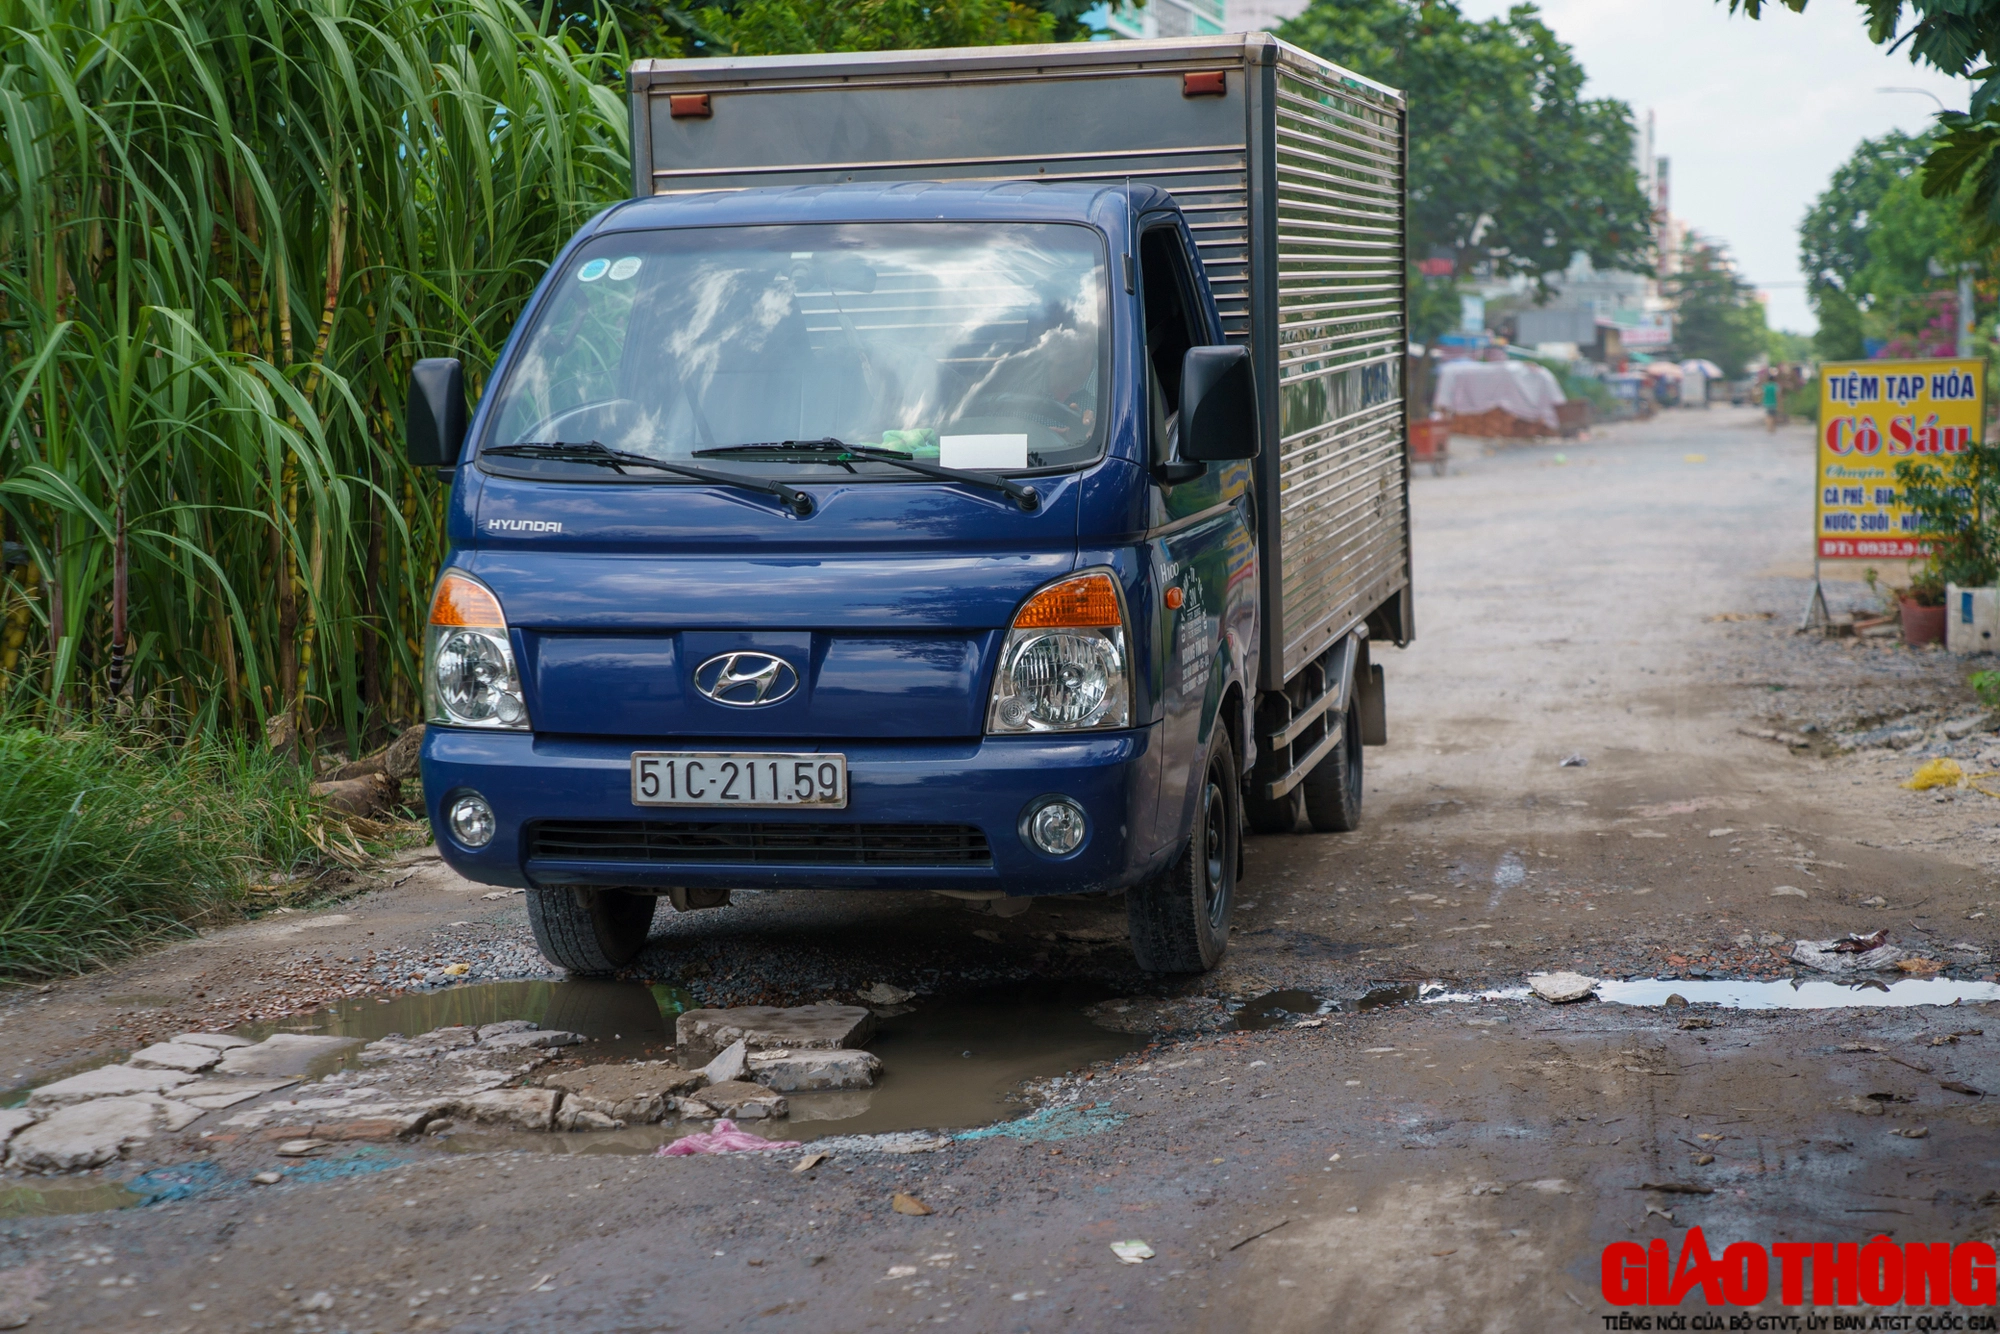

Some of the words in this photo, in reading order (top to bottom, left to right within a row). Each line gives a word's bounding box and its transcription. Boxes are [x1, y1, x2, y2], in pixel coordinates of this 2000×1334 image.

[1829, 371, 1879, 407] TIỆM
[1886, 376, 1925, 407] TẠP
[1932, 369, 1975, 400] HÓA
[1826, 416, 1882, 456] Cô
[1889, 412, 1972, 456] Sáu
[1824, 485, 1839, 505] CÀ
[488, 519, 562, 533] HYUNDAI
[1824, 510, 1856, 531] NƯỚC
[1860, 509, 1889, 531] SUỐI
[1160, 562, 1179, 583] H100
[640, 760, 838, 800] 51C-211.59
